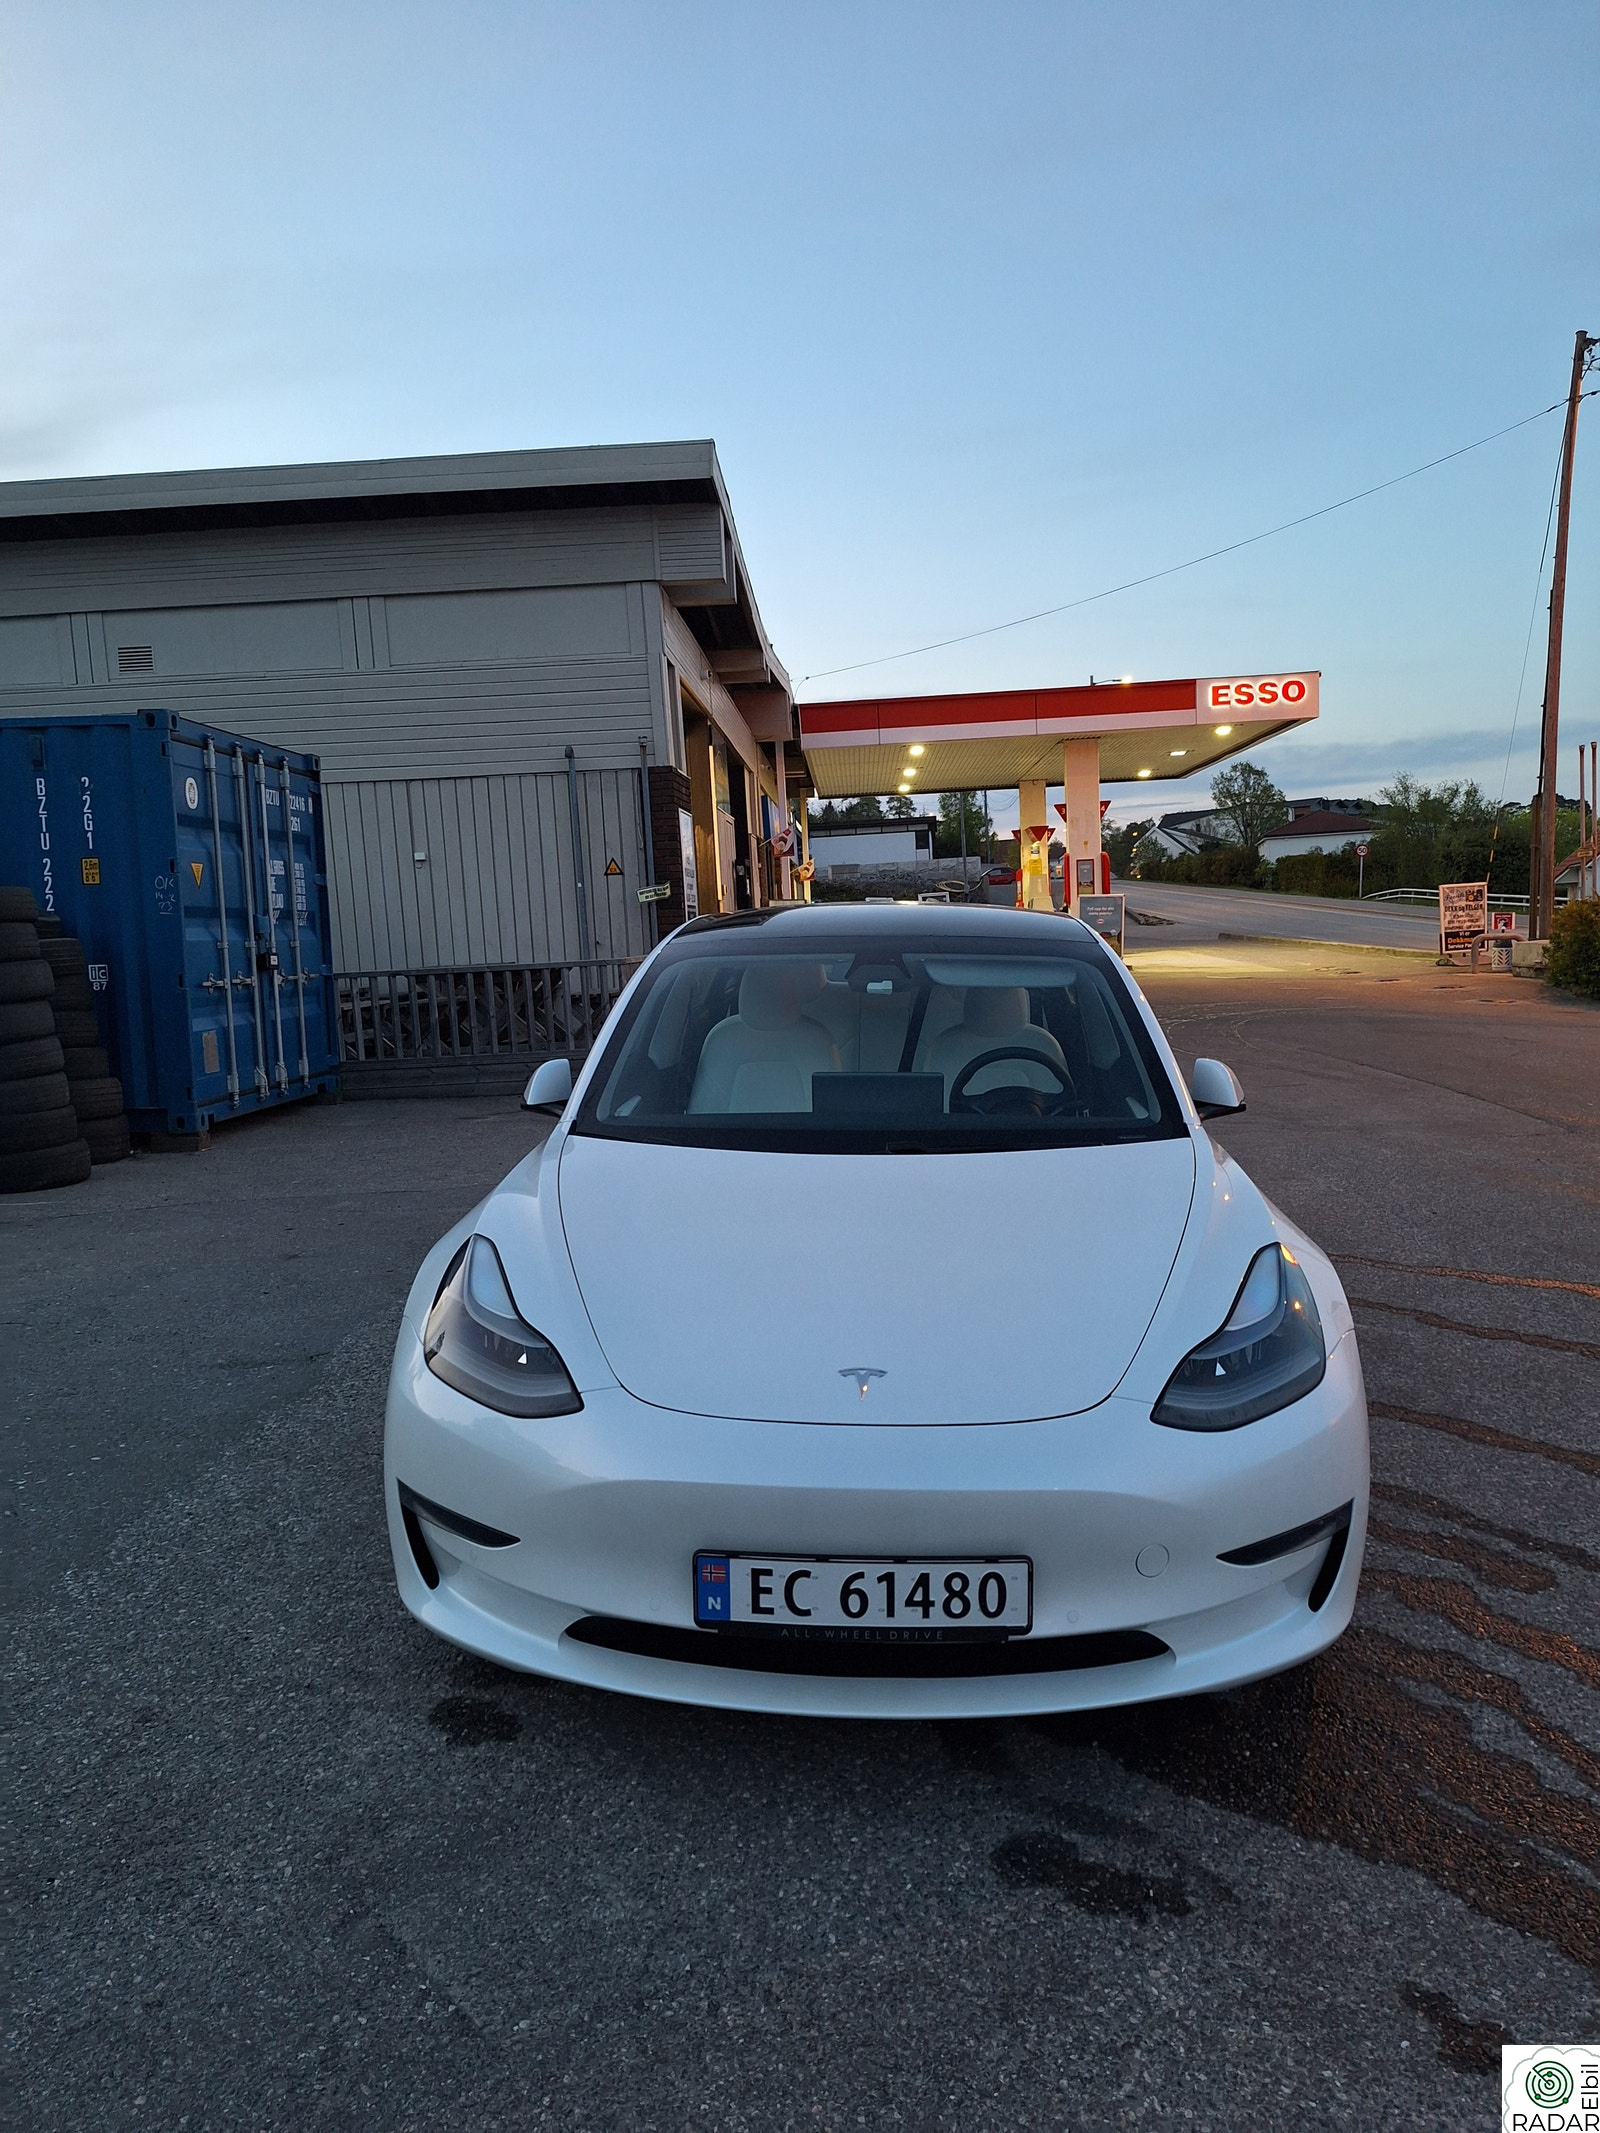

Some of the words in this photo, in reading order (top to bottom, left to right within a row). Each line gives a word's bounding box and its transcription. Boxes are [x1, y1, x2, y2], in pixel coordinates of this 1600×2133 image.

[1211, 680, 1306, 706] ESSO
[289, 794, 306, 812] 22416
[36, 777, 51, 851] BZTU
[290, 816, 301, 832] 2G1
[93, 981, 108, 991] 87
[750, 1567, 813, 1617] EC
[839, 1571, 1008, 1619] 61480
[708, 1596, 721, 1611] N
[889, 1630, 945, 1641] DRIVE
